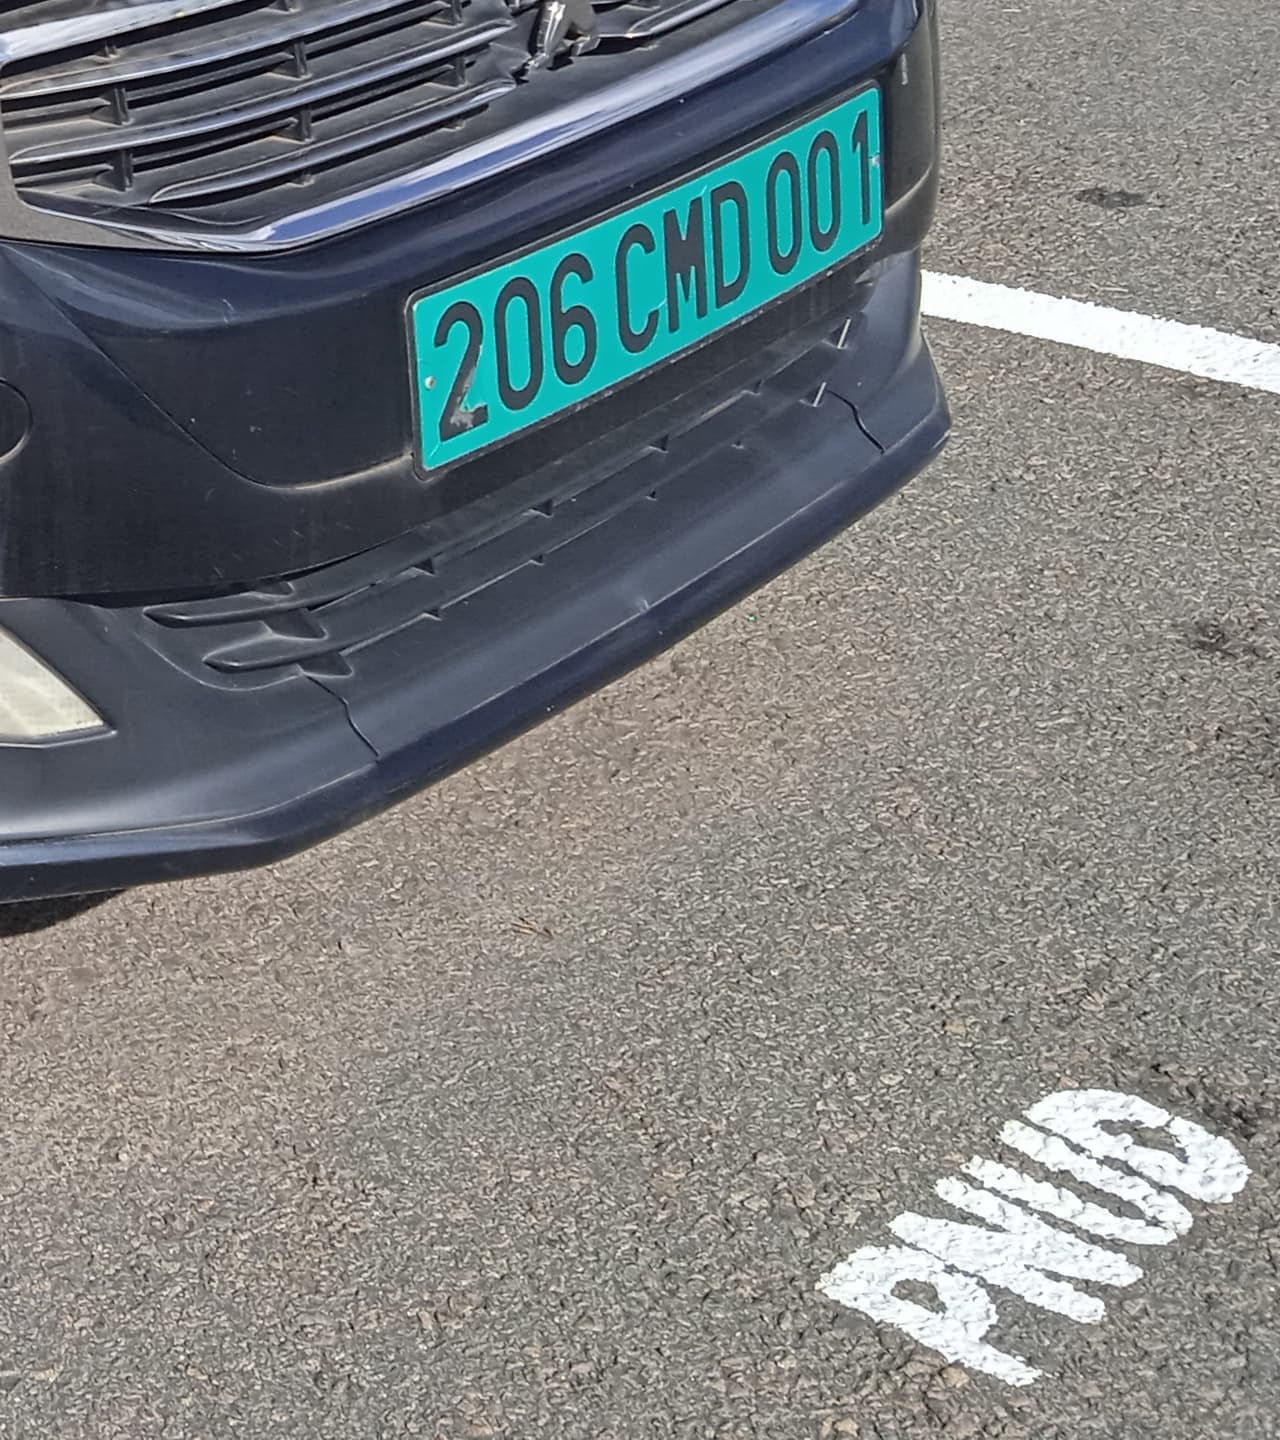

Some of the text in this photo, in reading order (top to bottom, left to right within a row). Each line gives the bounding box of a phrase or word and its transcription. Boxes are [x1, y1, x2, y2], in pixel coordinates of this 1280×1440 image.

[434, 110, 870, 441] 206 CMD 001
[815, 1088, 1252, 1386] PNUD
